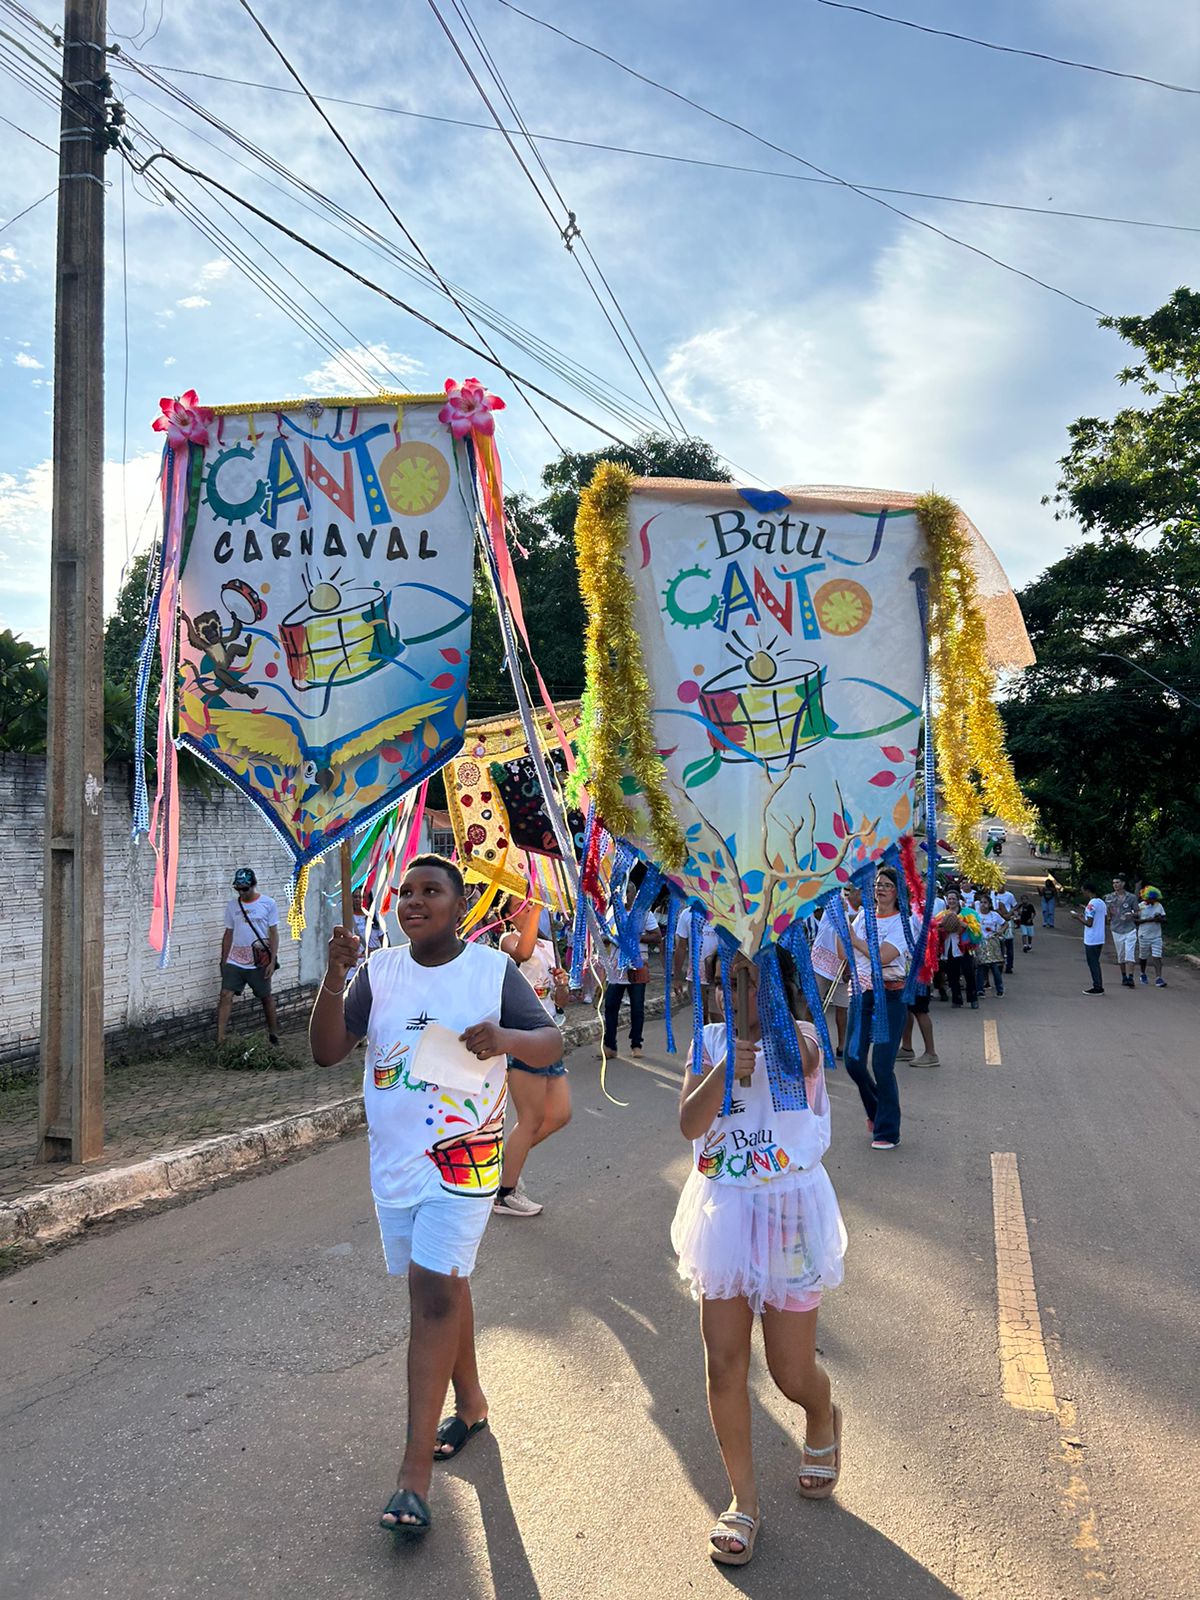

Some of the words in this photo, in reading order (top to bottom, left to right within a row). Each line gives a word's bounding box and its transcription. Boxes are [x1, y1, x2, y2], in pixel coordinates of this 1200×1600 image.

[201, 423, 450, 529] CANTO
[213, 523, 438, 564] CARNAVAL
[705, 509, 826, 560] Batu
[661, 560, 873, 640] CANTO
[725, 1144, 790, 1178] CANTO
[730, 1129, 774, 1150] Batu
